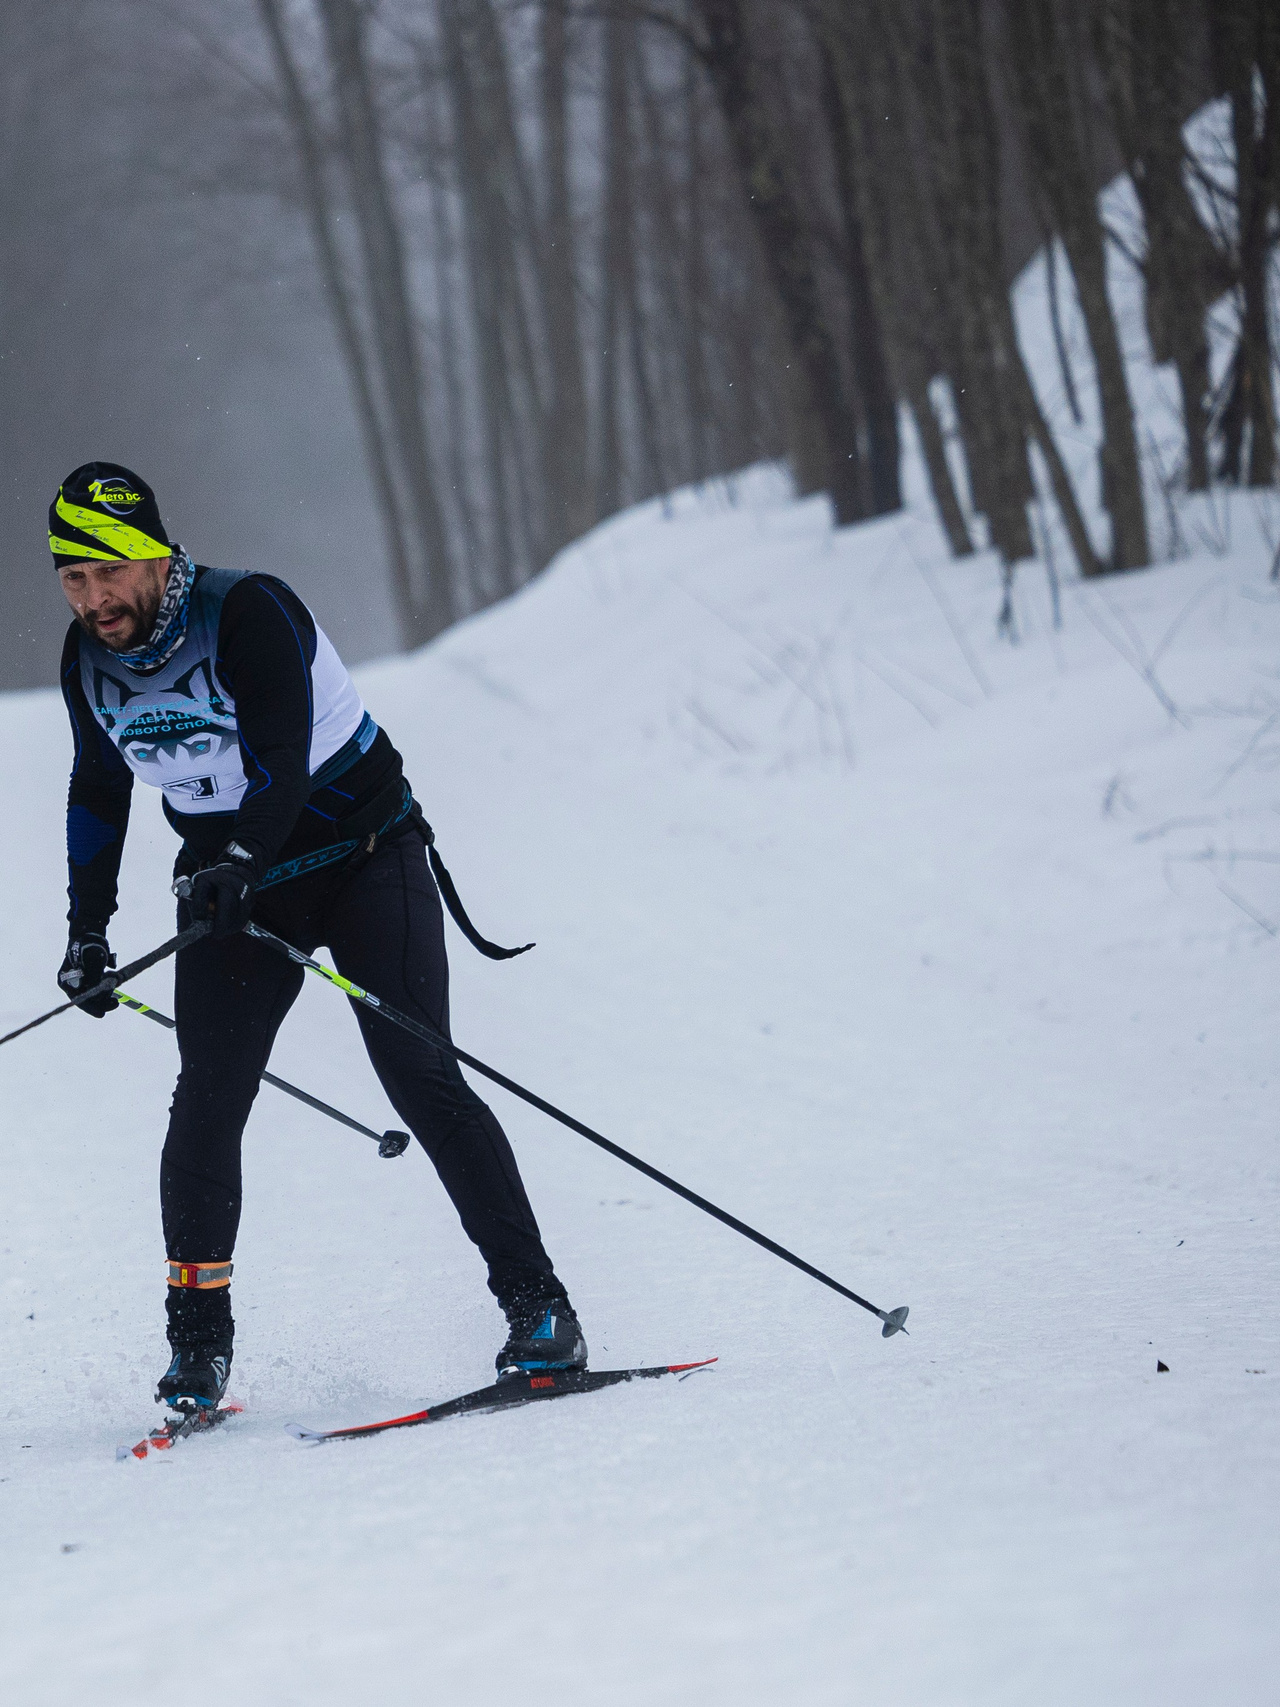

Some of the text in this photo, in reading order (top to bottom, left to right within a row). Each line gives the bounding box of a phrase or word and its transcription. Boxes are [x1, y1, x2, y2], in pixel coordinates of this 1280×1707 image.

[88, 481, 124, 502] Zero
[114, 707, 214, 726] ФЕДЕРАЦИЯ
[175, 714, 233, 731] СПОРТА
